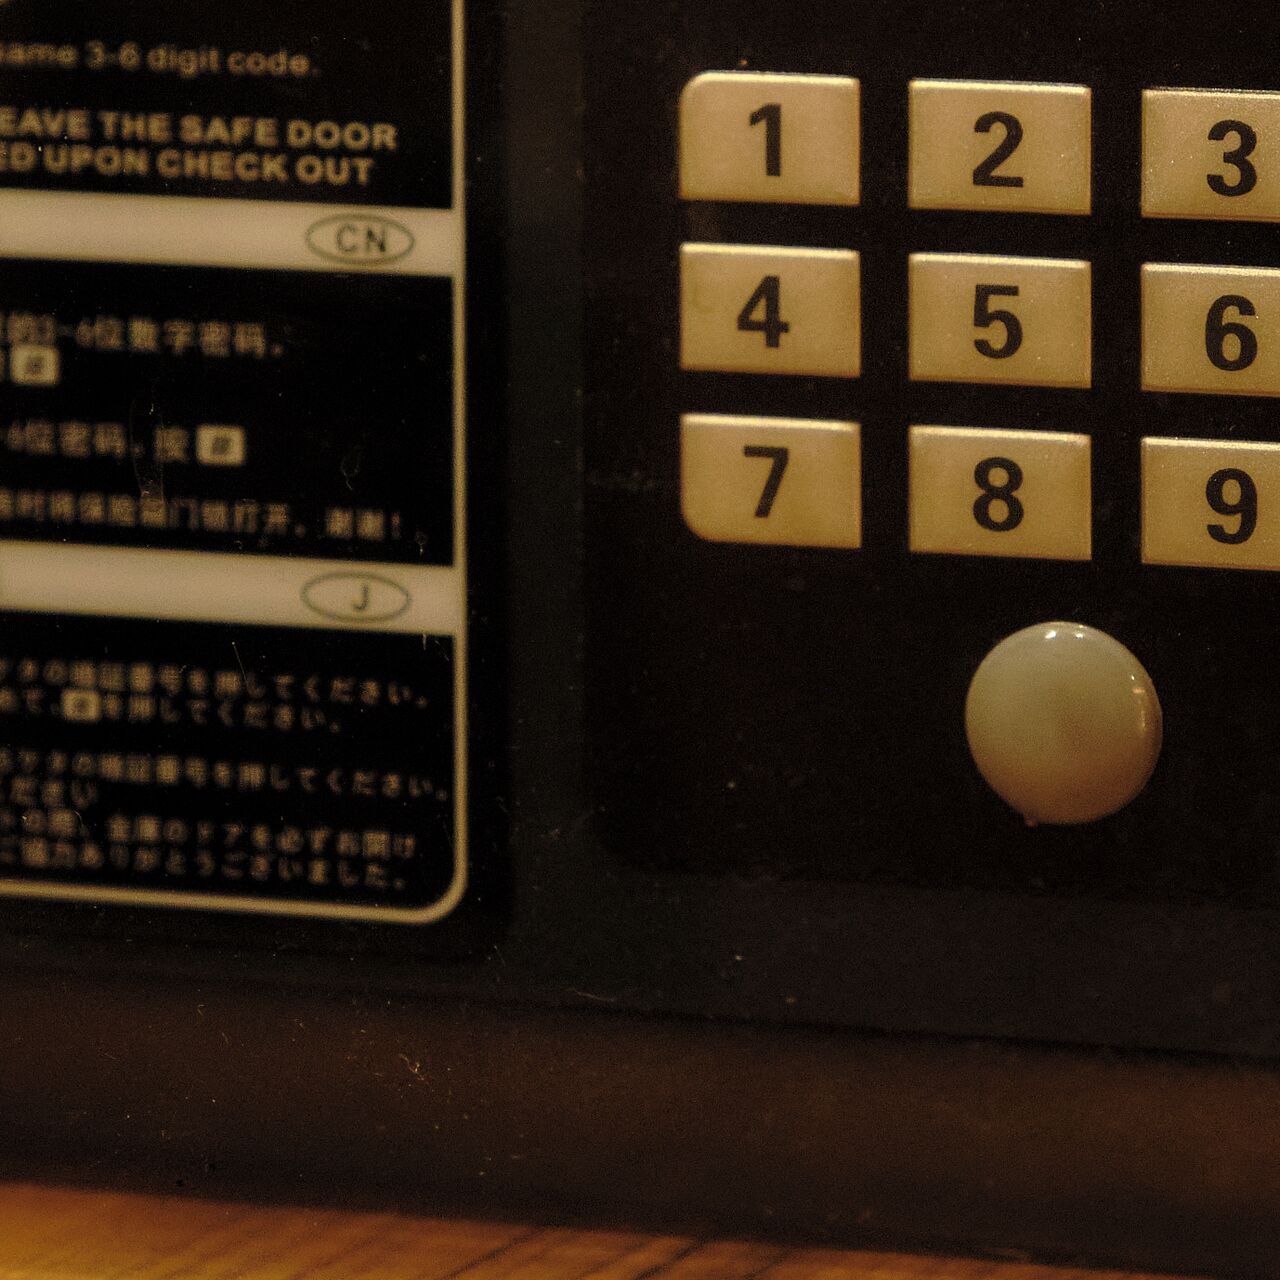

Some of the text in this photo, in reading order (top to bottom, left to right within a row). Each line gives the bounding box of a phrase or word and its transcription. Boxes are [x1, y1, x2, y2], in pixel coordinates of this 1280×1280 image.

[84, 37, 141, 69] 3-6
[146, 40, 221, 78] digit
[226, 46, 320, 78] code.
[97, 109, 173, 145] THE
[178, 113, 279, 149] SAFE
[286, 119, 399, 153] DOOR
[747, 103, 783, 178] 1
[972, 112, 1025, 189] 2
[1205, 119, 1258, 198] 3
[43, 145, 150, 179] UPON
[156, 150, 289, 184] CHECK
[295, 154, 376, 187] OUT
[334, 226, 389, 257] CN
[736, 274, 790, 349] 4
[972, 283, 1025, 359] 5
[1204, 294, 1259, 373] 6
[741, 445, 790, 519] 7
[972, 457, 1025, 533] 8
[1205, 468, 1259, 546] 9
[352, 583, 370, 612] J
